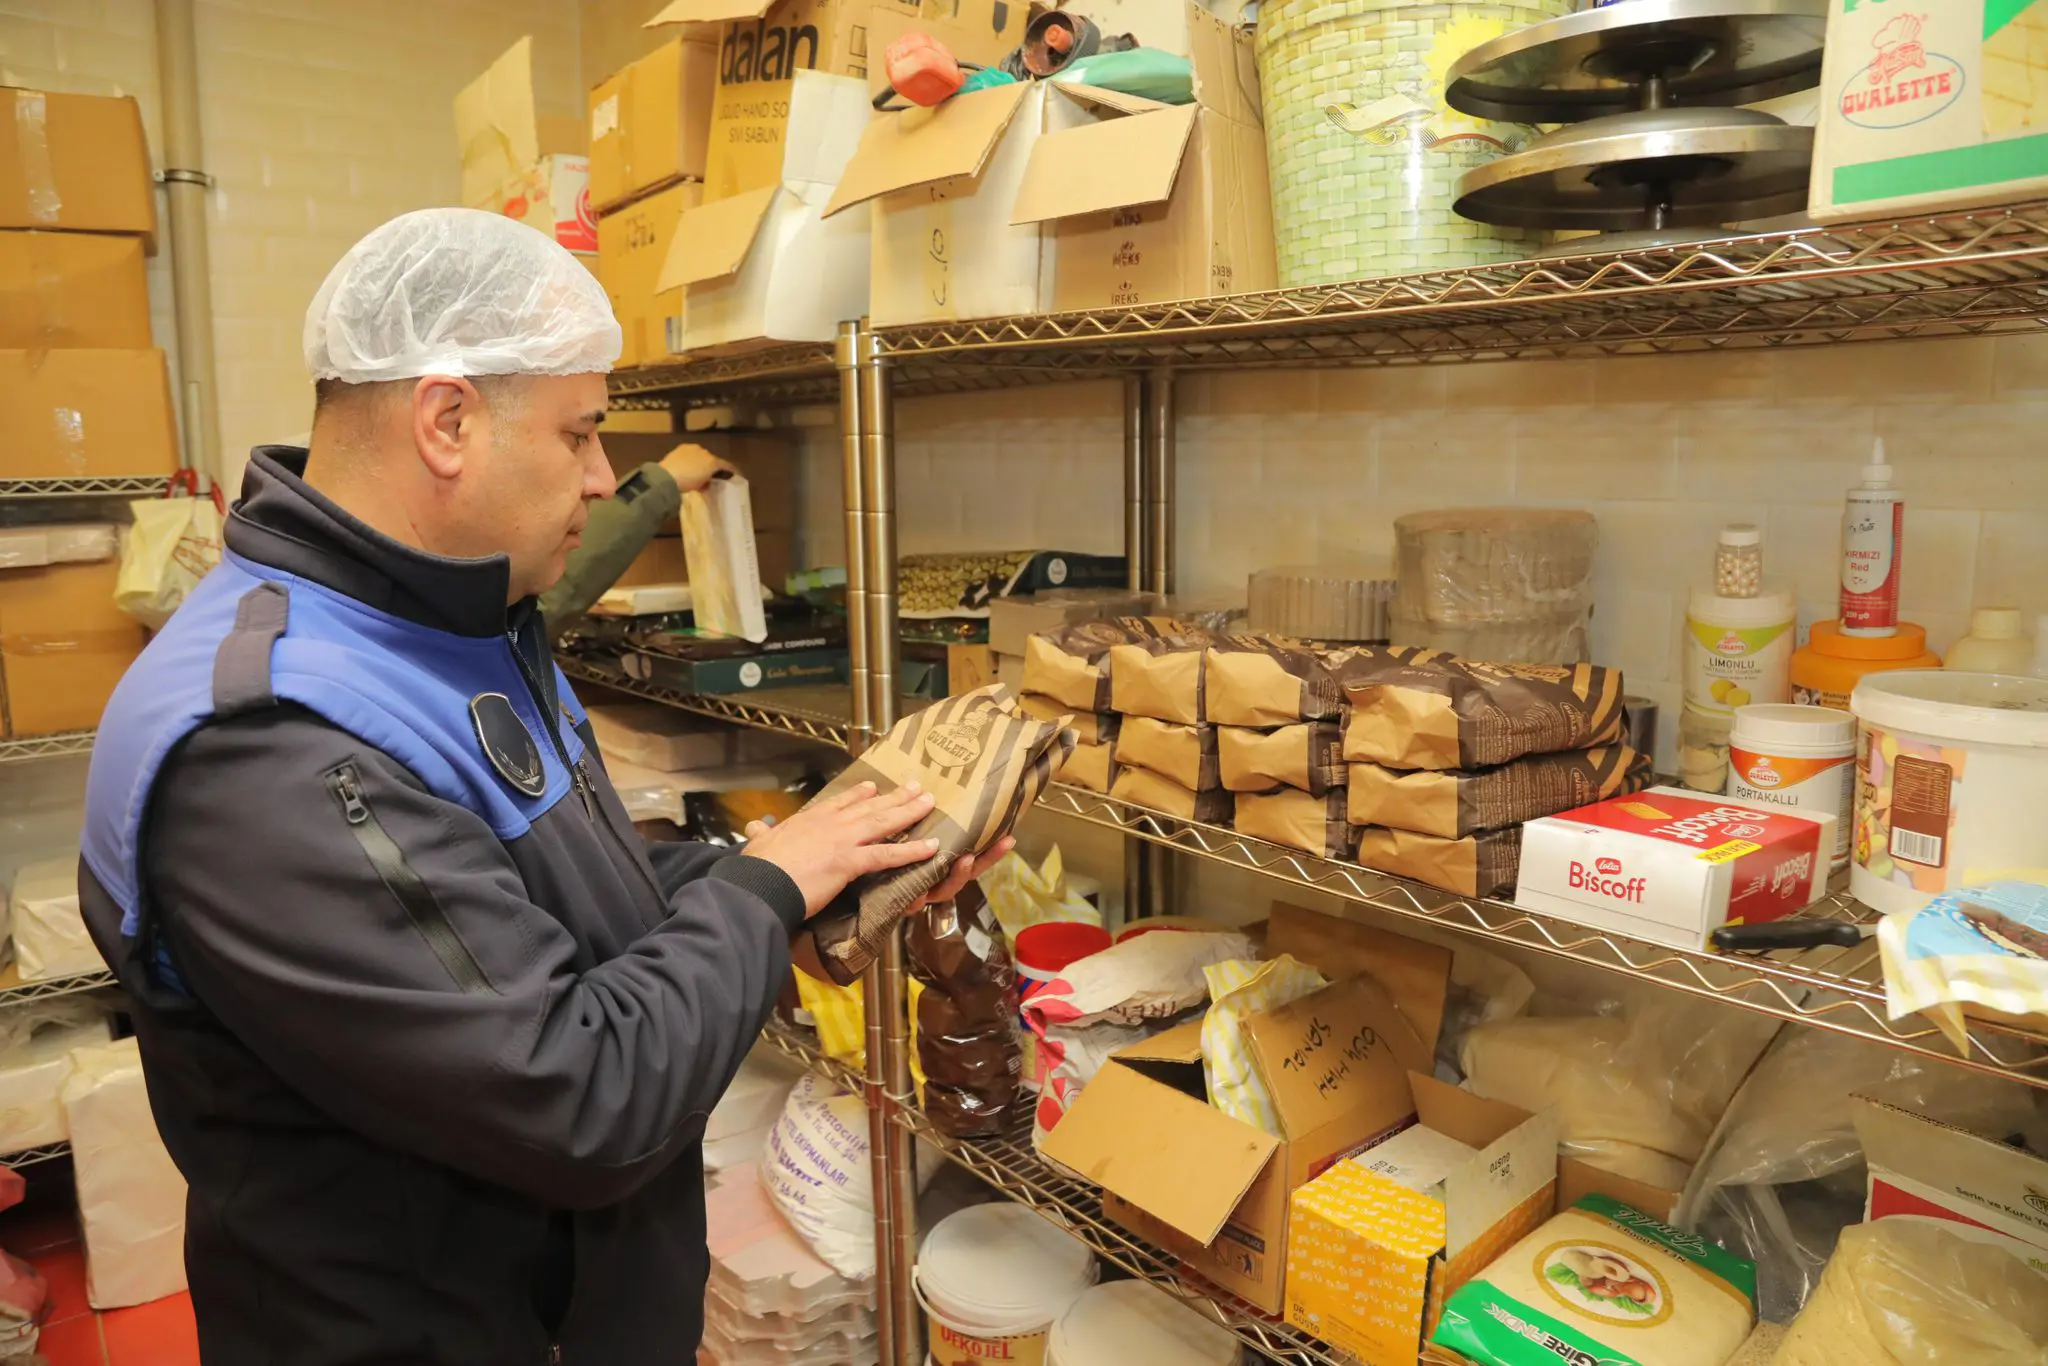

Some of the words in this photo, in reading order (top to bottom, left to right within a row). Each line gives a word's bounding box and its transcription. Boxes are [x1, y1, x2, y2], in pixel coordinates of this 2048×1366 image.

[721, 18, 818, 86] dalan
[772, 101, 789, 119] SO
[1111, 293, 1139, 305] IREKS
[1850, 562, 1869, 572] Red
[1709, 657, 1755, 669] LİMONLU
[927, 730, 975, 762] OVALETTE
[1736, 786, 1798, 806] PORTAKALLI
[1649, 807, 1770, 843] Biscoff
[1569, 861, 1647, 903] Biscoff
[1489, 1152, 1511, 1174] GUSTO
[2004, 1205, 2032, 1221] Kuru
